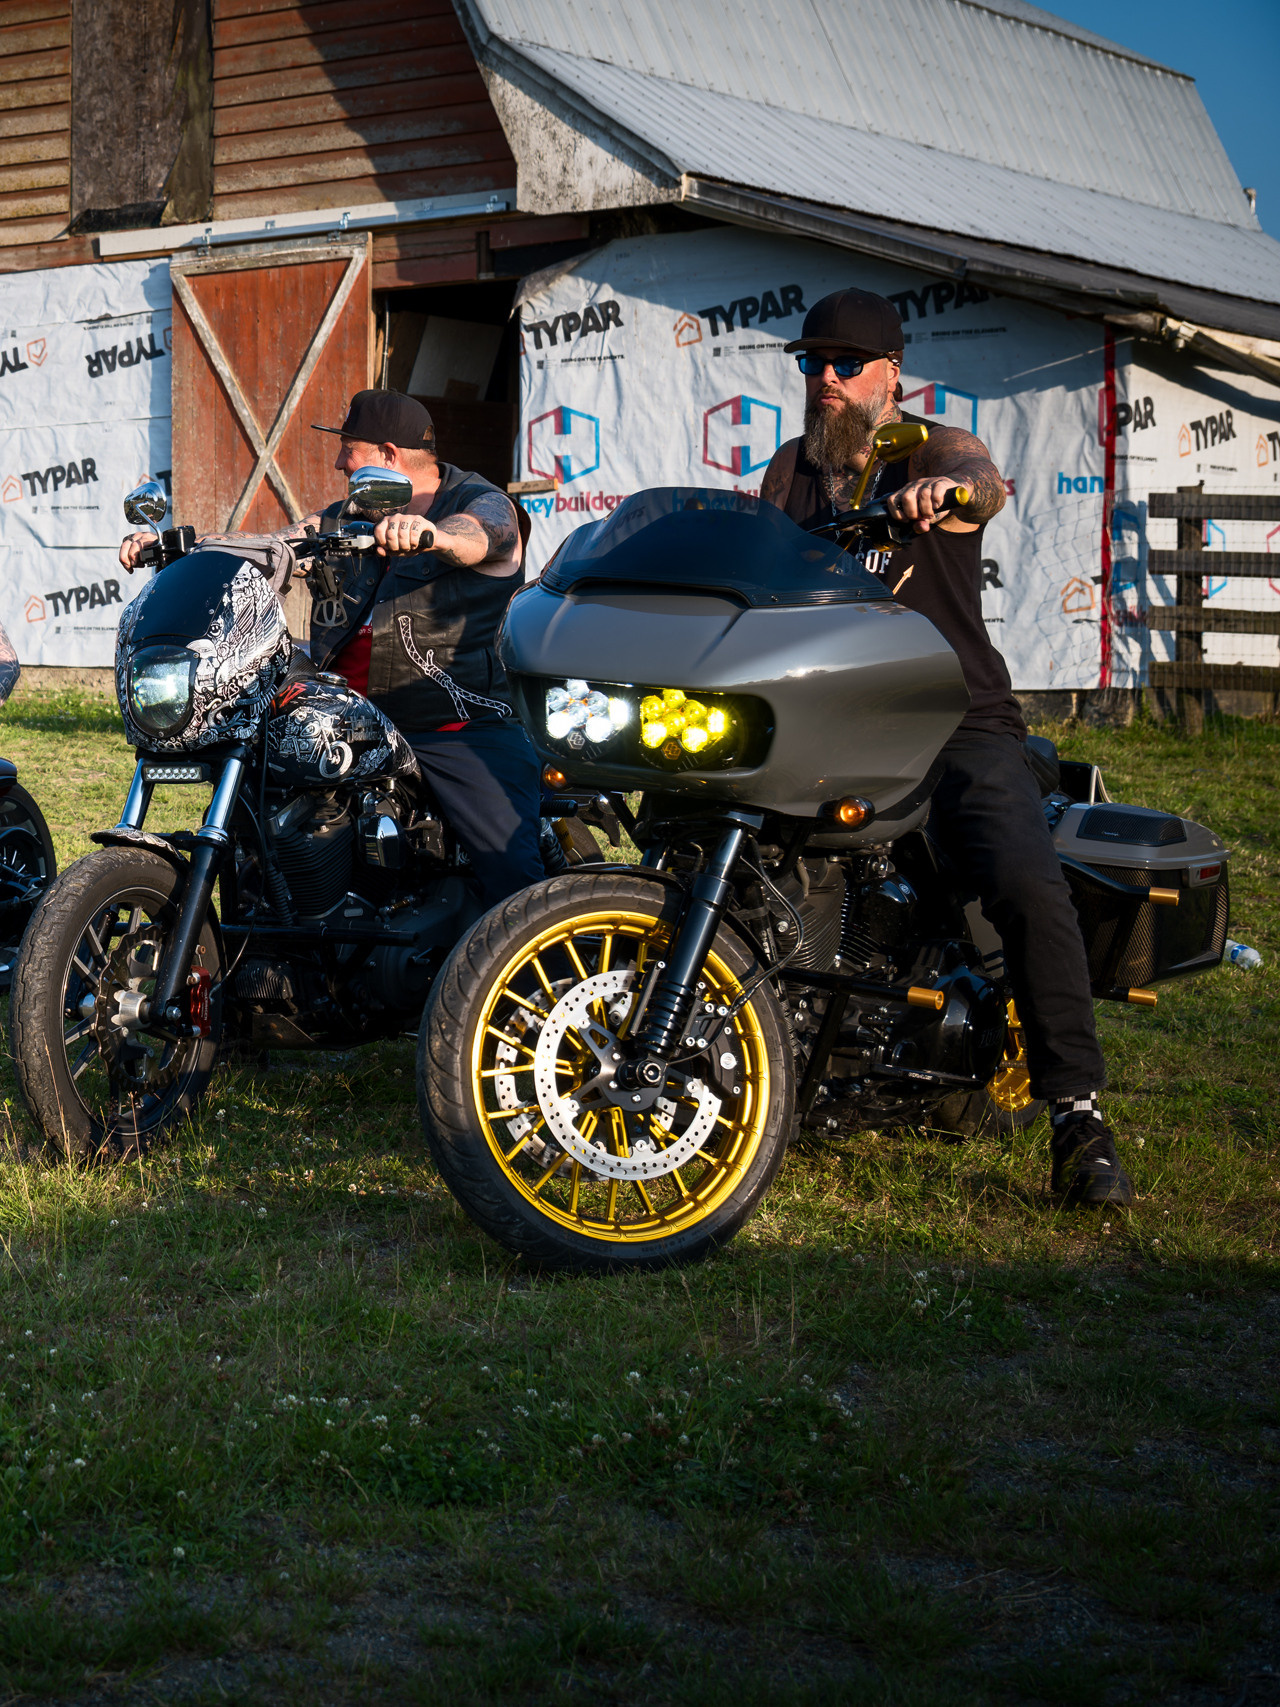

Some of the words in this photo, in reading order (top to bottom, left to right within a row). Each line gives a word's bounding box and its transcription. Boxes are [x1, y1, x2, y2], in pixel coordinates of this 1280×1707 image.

[697, 284, 808, 337] TYPAR
[886, 281, 996, 323] TYPA
[524, 299, 624, 350] TYPAR
[85, 332, 166, 379] TYPAR
[1113, 396, 1156, 437] PAR
[1189, 409, 1237, 452] TYPAR
[21, 457, 99, 496] TYPAR
[865, 548, 892, 574] OF
[45, 579, 123, 617] TYPAR
